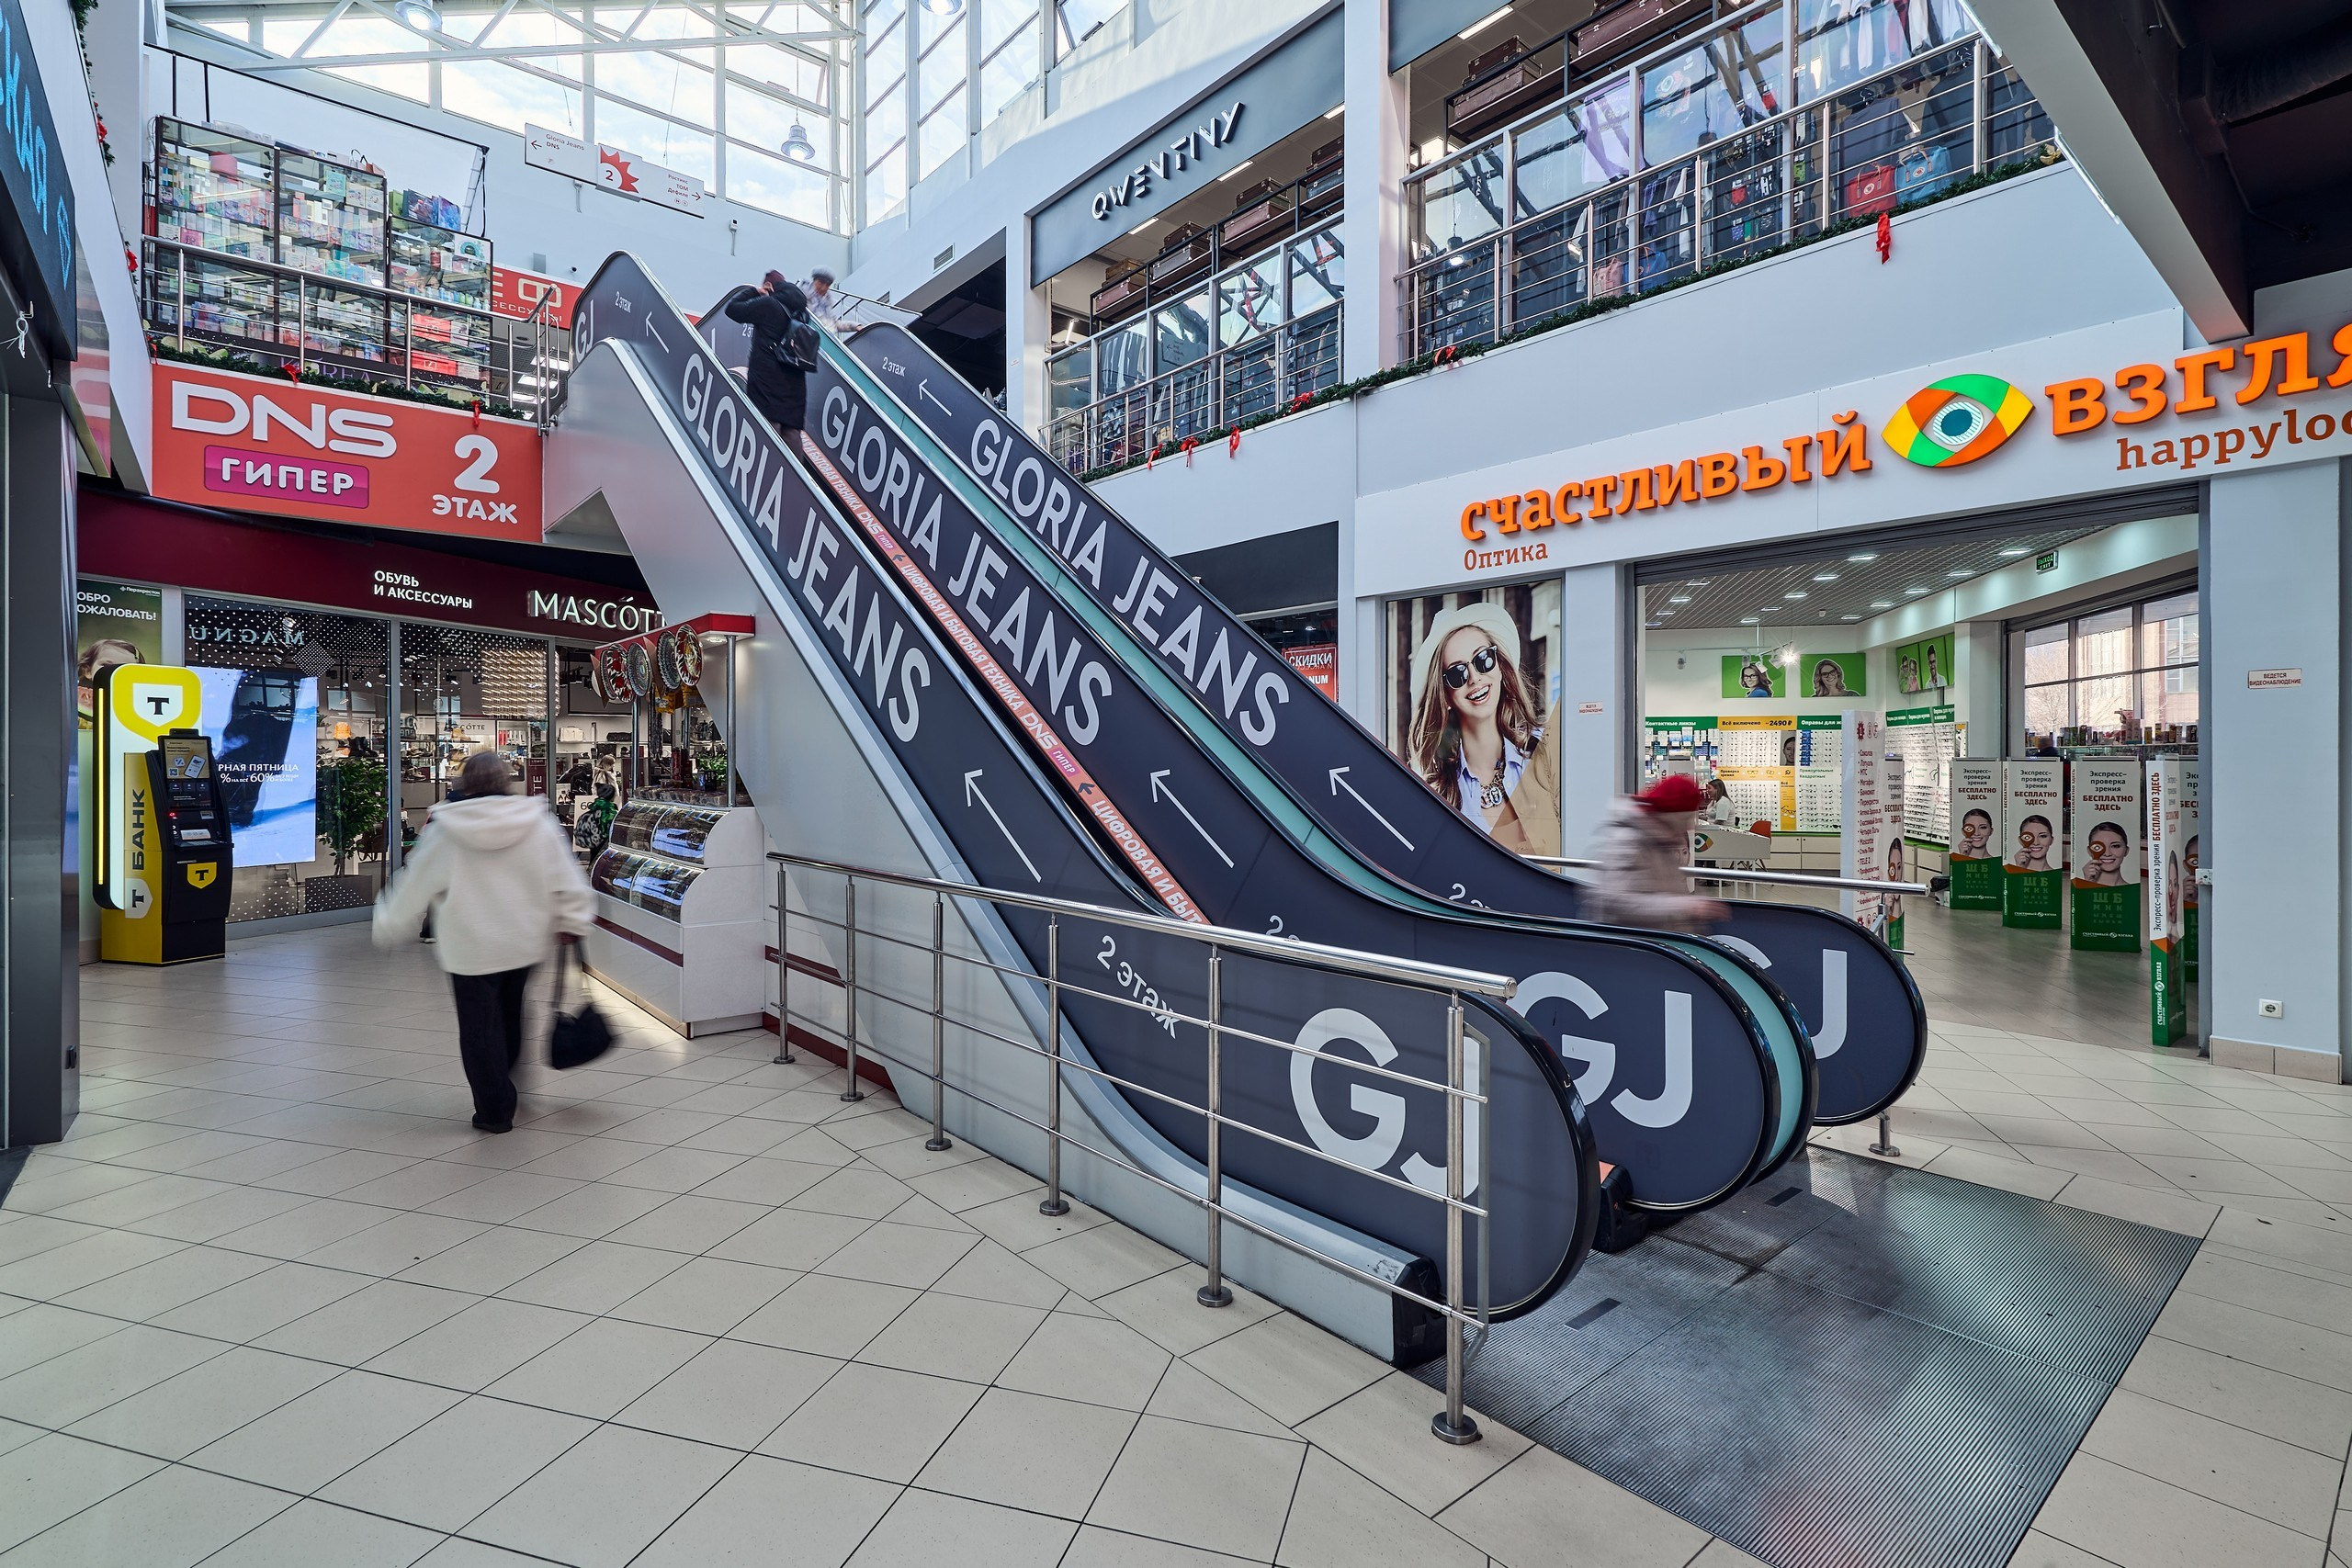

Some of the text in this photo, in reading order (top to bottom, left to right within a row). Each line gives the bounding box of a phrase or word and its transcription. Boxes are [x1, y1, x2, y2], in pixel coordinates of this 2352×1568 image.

[0, 17, 48, 235] КАЯ
[546, 133, 584, 151] Gloria Jeans
[546, 141, 560, 150] DNS
[605, 170, 614, 182] 2
[668, 174, 688, 185] Ростикс
[667, 188, 688, 198] Дефиле
[615, 291, 632, 314] 2 этаж
[576, 299, 594, 364] GJ
[882, 356, 906, 377] 2 этаж
[171, 378, 397, 458] DNS
[220, 457, 355, 496] ГИПЕР
[453, 434, 501, 494] 2
[1461, 410, 1873, 541] счастливый
[431, 494, 518, 525] ЭТАЖ
[832, 478, 864, 511] ТЕХНИКА
[857, 511, 883, 535] DNS
[877, 535, 894, 549] ГИПЕР
[682, 353, 931, 742] GLORIA JEANS
[1464, 543, 1548, 571] Оптика
[374, 570, 420, 588] ОБУВЬ
[822, 386, 1113, 746] GLORIA JEANS
[126, 586, 161, 595] Перекресток
[373, 584, 472, 609] И АКСЕССУАРЫ
[971, 419, 1289, 746] GLORIA JEANS
[76, 592, 111, 604] ОБРО
[76, 604, 157, 621] ОЖАЛОВАТЬ!
[900, 564, 1076, 773] ЦИФРОВАЯ И БЫТОВАЯ ТЕХНИКА DNS ГИПЕР
[1288, 652, 1332, 669] СКИДКИ
[459, 722, 486, 730] CÓTTE
[218, 763, 299, 772] РНАЯ ПЯТНИЦА
[250, 773, 275, 783] 60%
[2151, 773, 2160, 795] ЗДЕСЬ
[2094, 804, 2121, 812] ЗДЕСЬ
[2152, 796, 2161, 841] БЕСПЛАТНО
[131, 788, 145, 871] БАНК
[1091, 800, 1164, 879] ЦИФРОВАЯ
[1154, 877, 1175, 893] И
[1449, 883, 1466, 900] 2
[2153, 867, 2161, 931] Экспресс-проверка
[1265, 915, 1283, 936] 2
[1096, 935, 1182, 1040] 2 этаж
[1709, 934, 1848, 1060] J
[1507, 970, 1693, 1129] GJ
[1290, 1007, 1480, 1200] GJ
